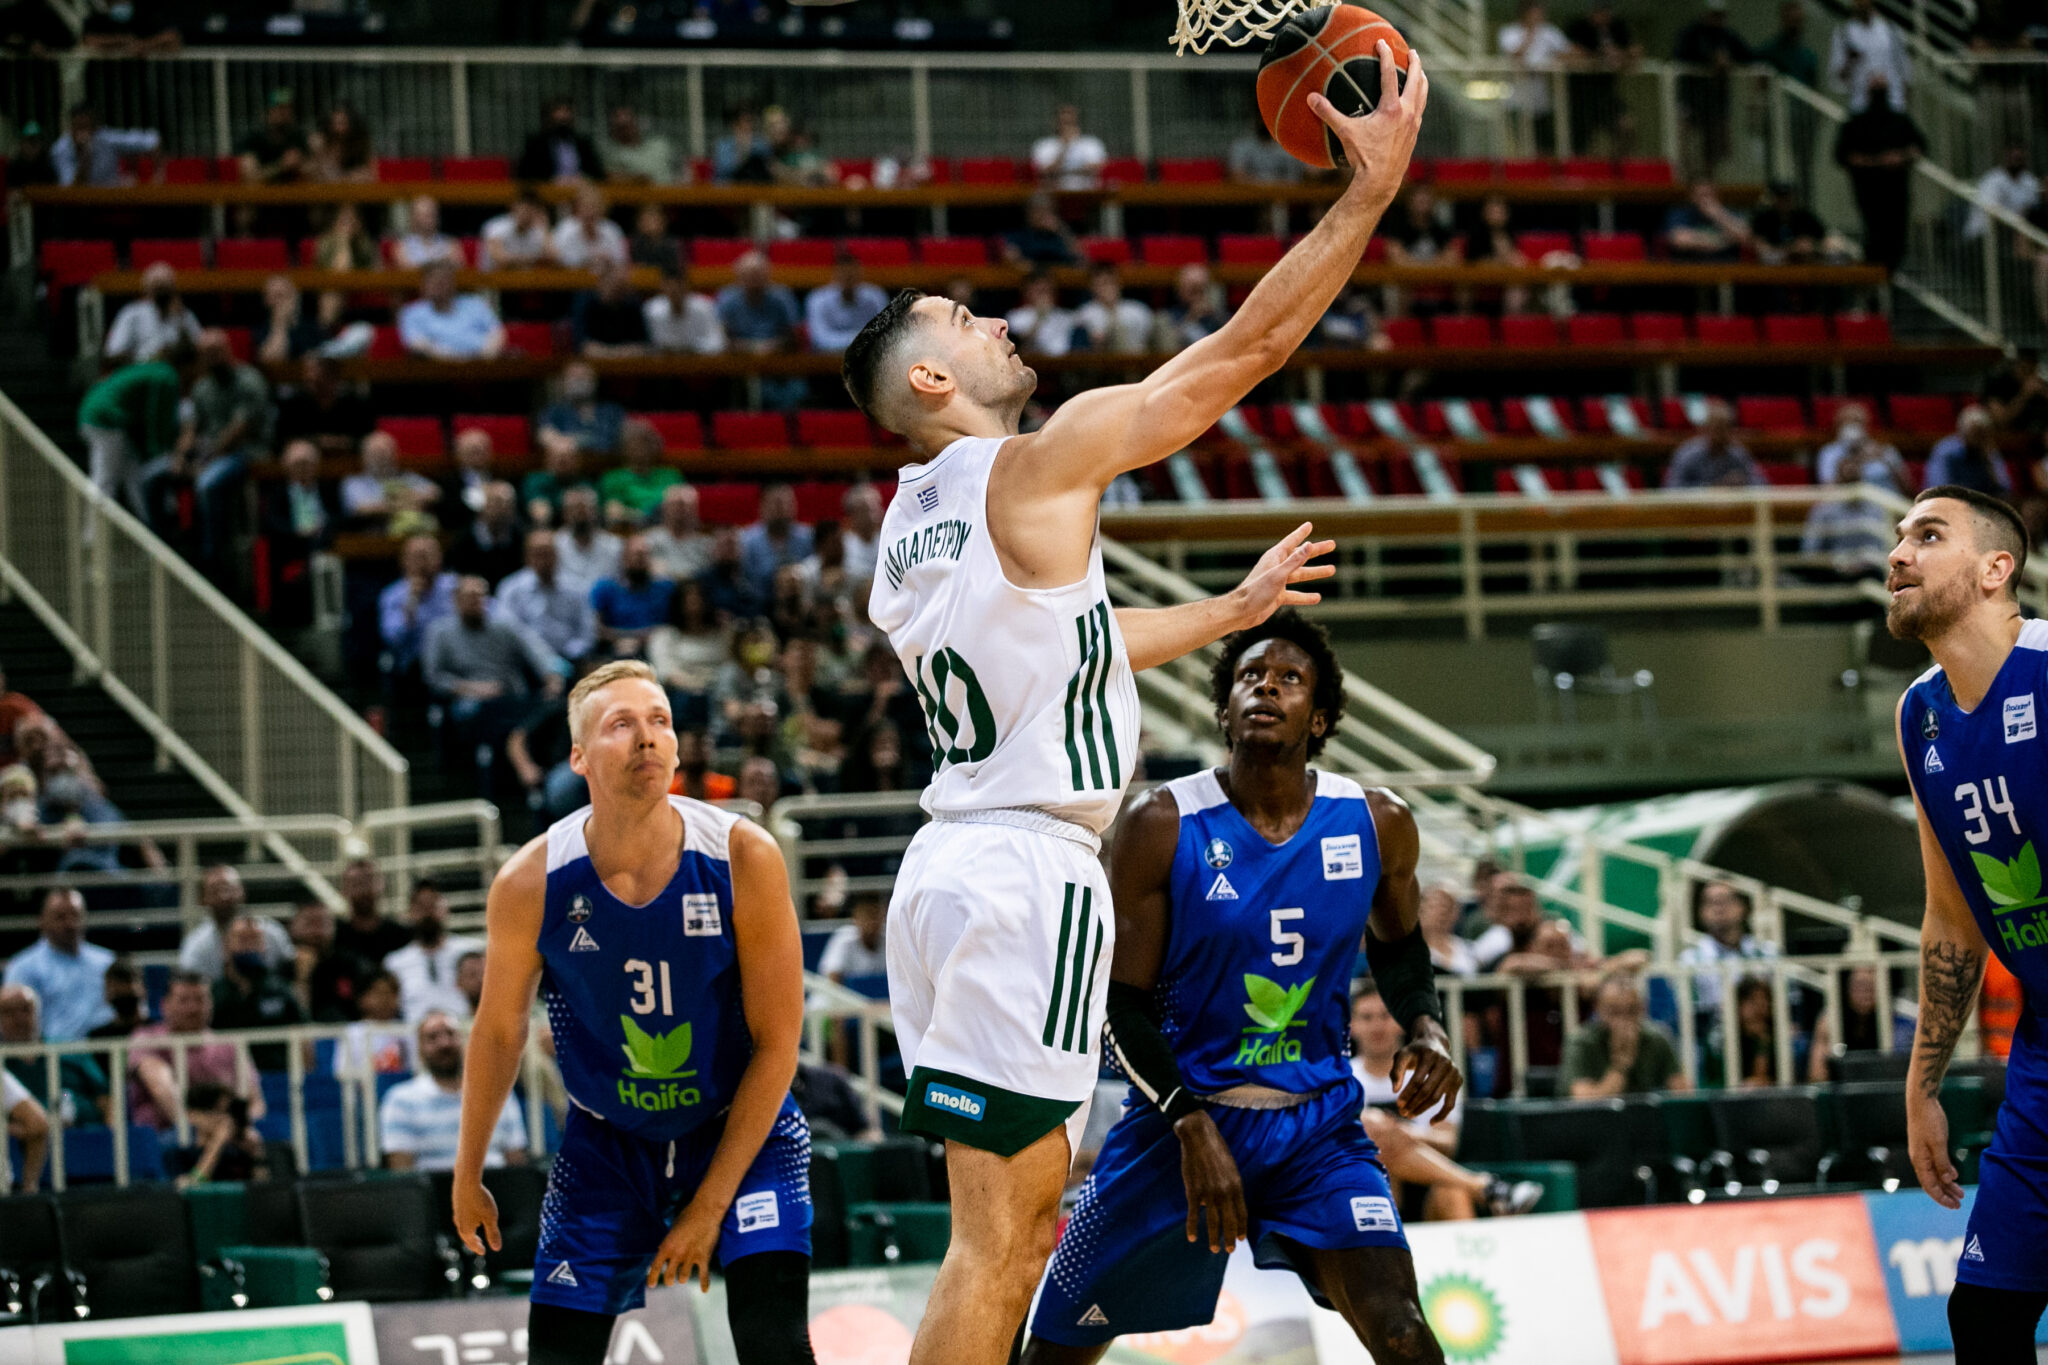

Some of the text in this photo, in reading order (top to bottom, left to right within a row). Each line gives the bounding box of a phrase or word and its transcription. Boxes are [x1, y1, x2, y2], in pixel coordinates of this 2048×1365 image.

[1954, 775, 2022, 845] 34
[1269, 907, 1305, 967] 5
[624, 958, 674, 1016] 31
[1232, 1031, 1302, 1066] Haifa
[617, 1079, 701, 1112] Haifa
[1640, 1238, 1851, 1331] AVIS
